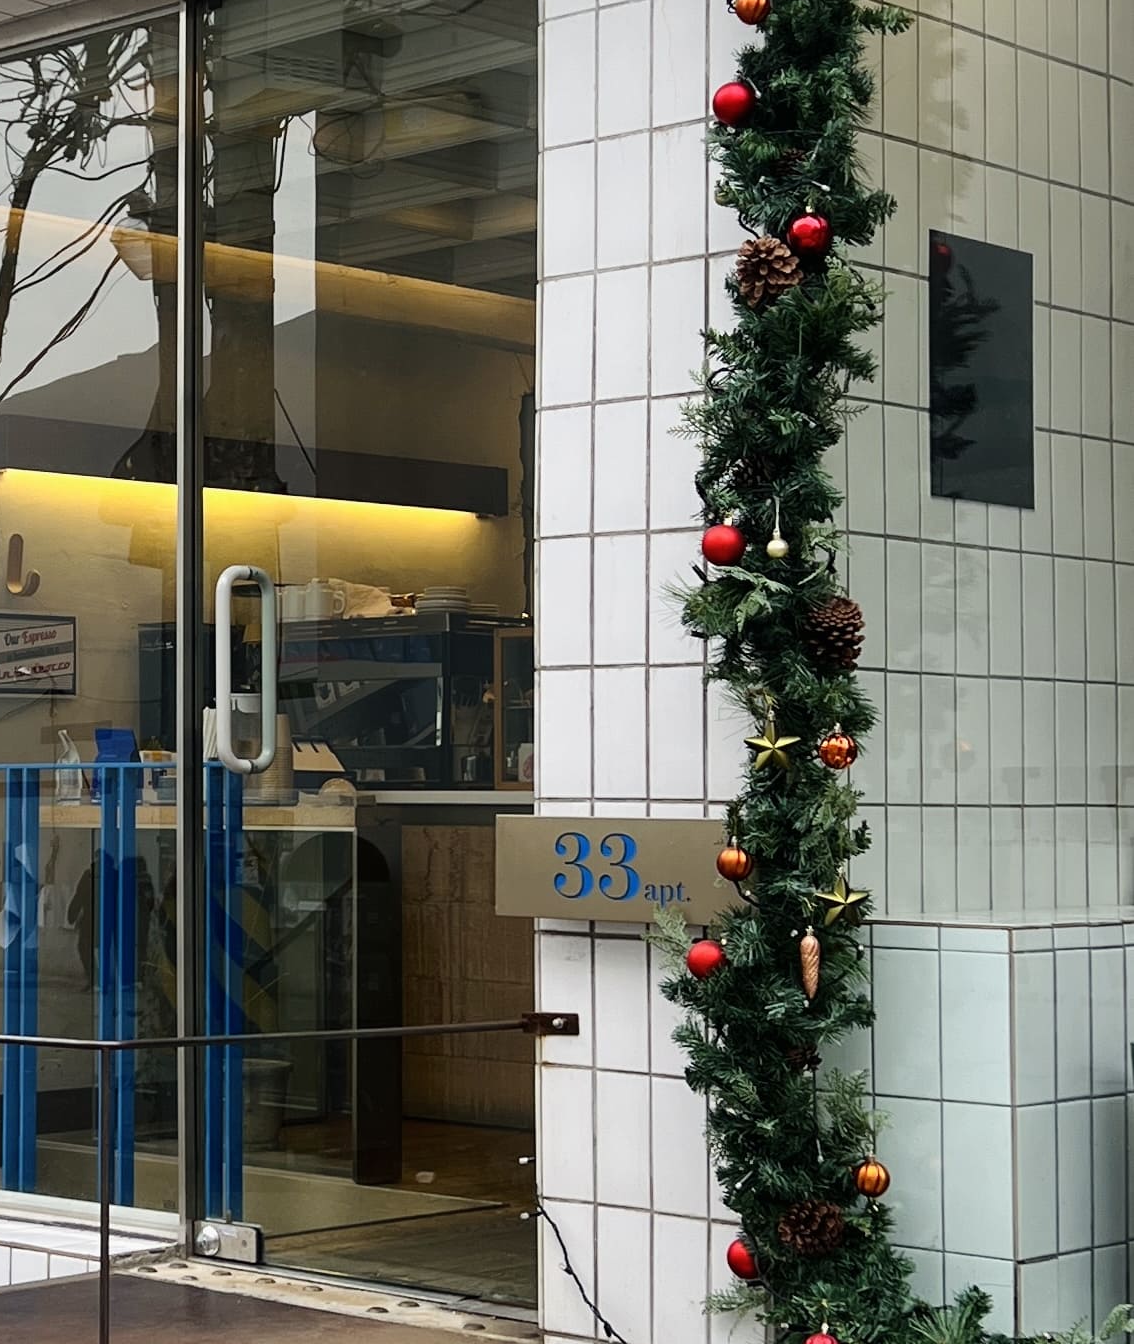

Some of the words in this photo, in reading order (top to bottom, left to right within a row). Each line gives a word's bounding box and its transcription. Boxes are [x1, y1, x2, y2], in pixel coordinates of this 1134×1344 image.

[4, 633, 20, 647] Our
[21, 629, 57, 646] Espresso
[553, 831, 641, 902] 33
[643, 881, 693, 910] apt.
